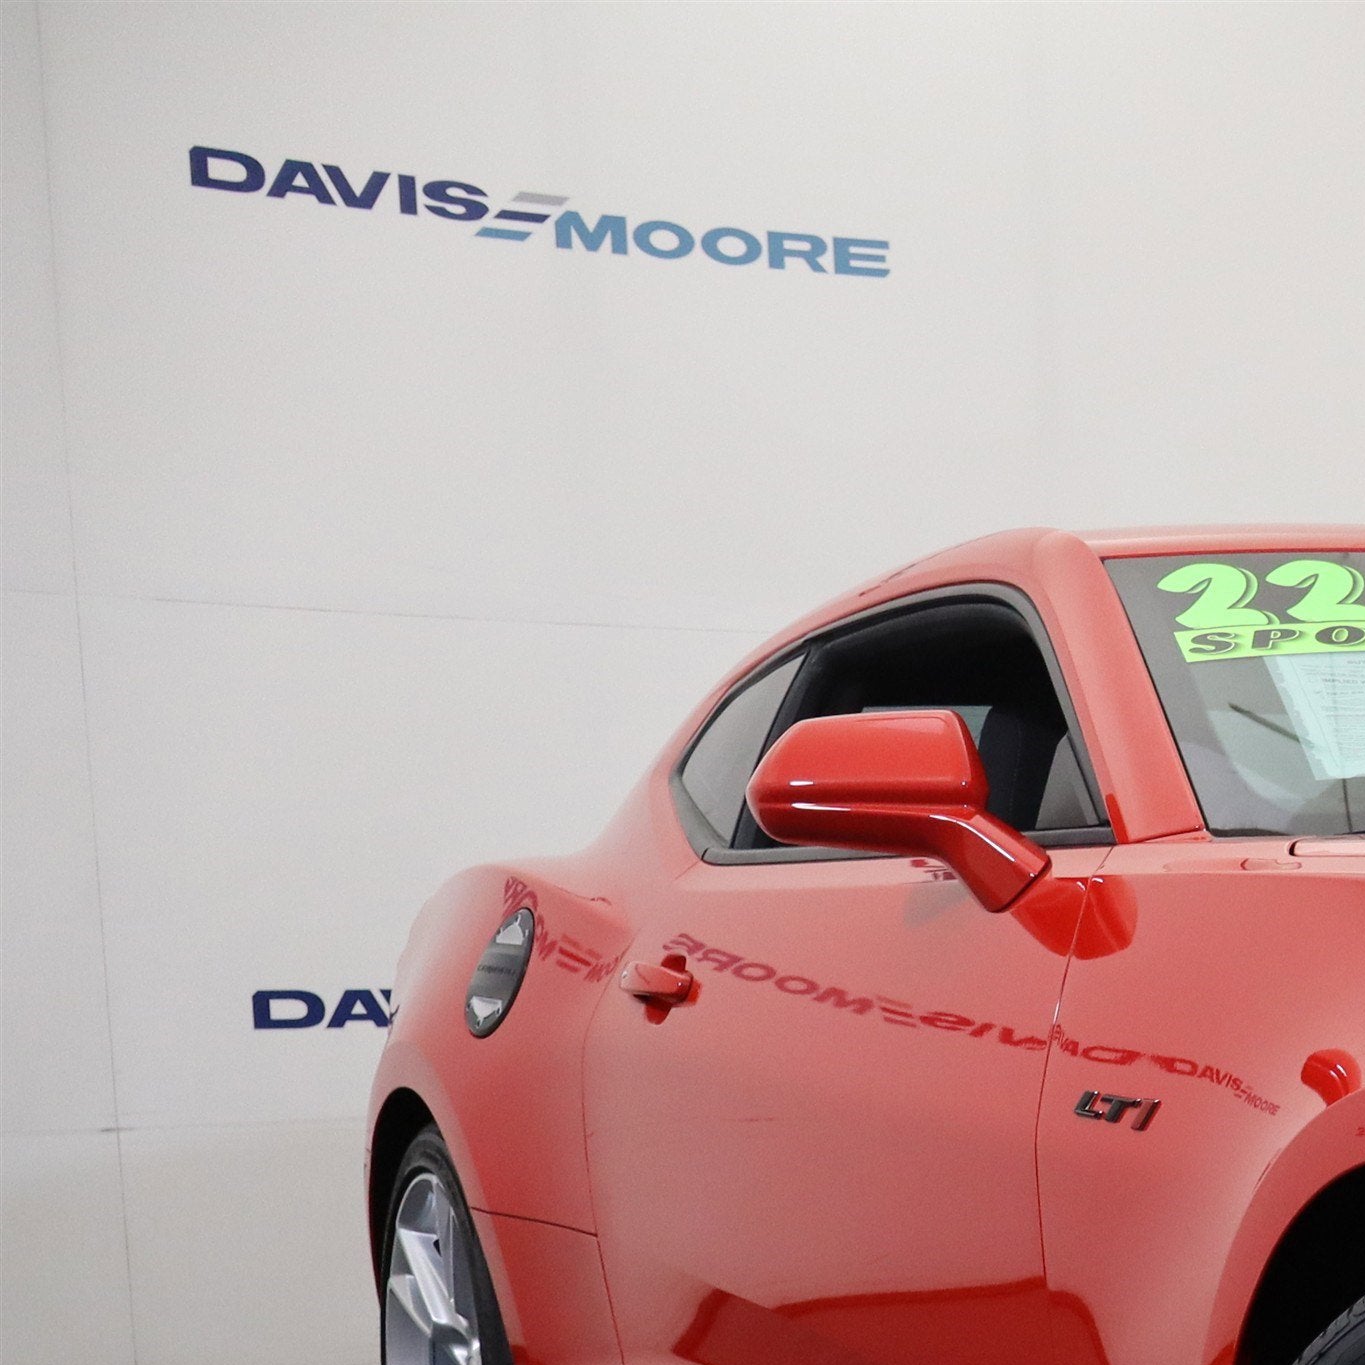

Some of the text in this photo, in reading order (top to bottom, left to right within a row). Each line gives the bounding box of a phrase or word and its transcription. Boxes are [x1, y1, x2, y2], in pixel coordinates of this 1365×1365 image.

[189, 145, 891, 278] DAVIS MOORE
[252, 989, 391, 1029] DA
